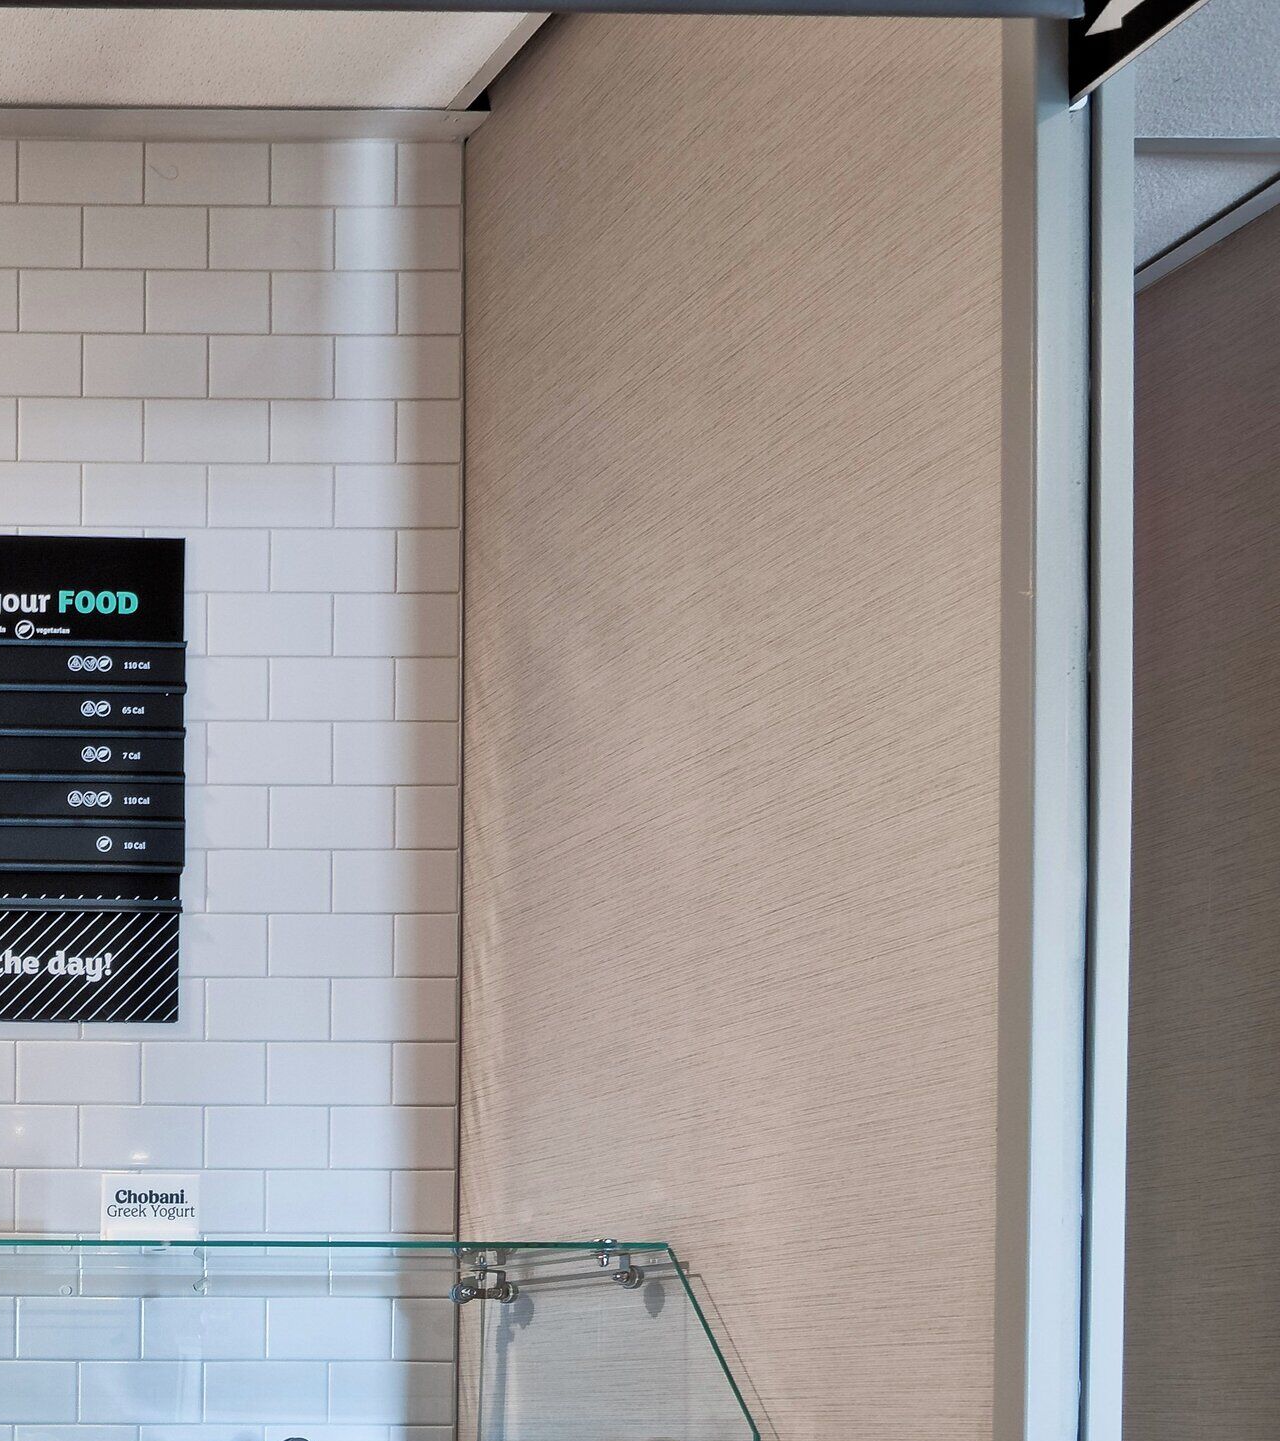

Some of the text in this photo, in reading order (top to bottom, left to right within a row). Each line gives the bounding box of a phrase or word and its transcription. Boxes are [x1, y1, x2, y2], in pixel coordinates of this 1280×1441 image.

[59, 590, 138, 614] FOOD
[124, 661, 151, 670] 110 Cal
[122, 706, 145, 715] 65 Cal
[122, 751, 141, 760] 7 Cal
[124, 796, 150, 805] 110 Cal
[124, 842, 146, 850] 10 Cal
[48, 951, 112, 982] day!
[107, 1203, 194, 1220] Greek Yogurt
